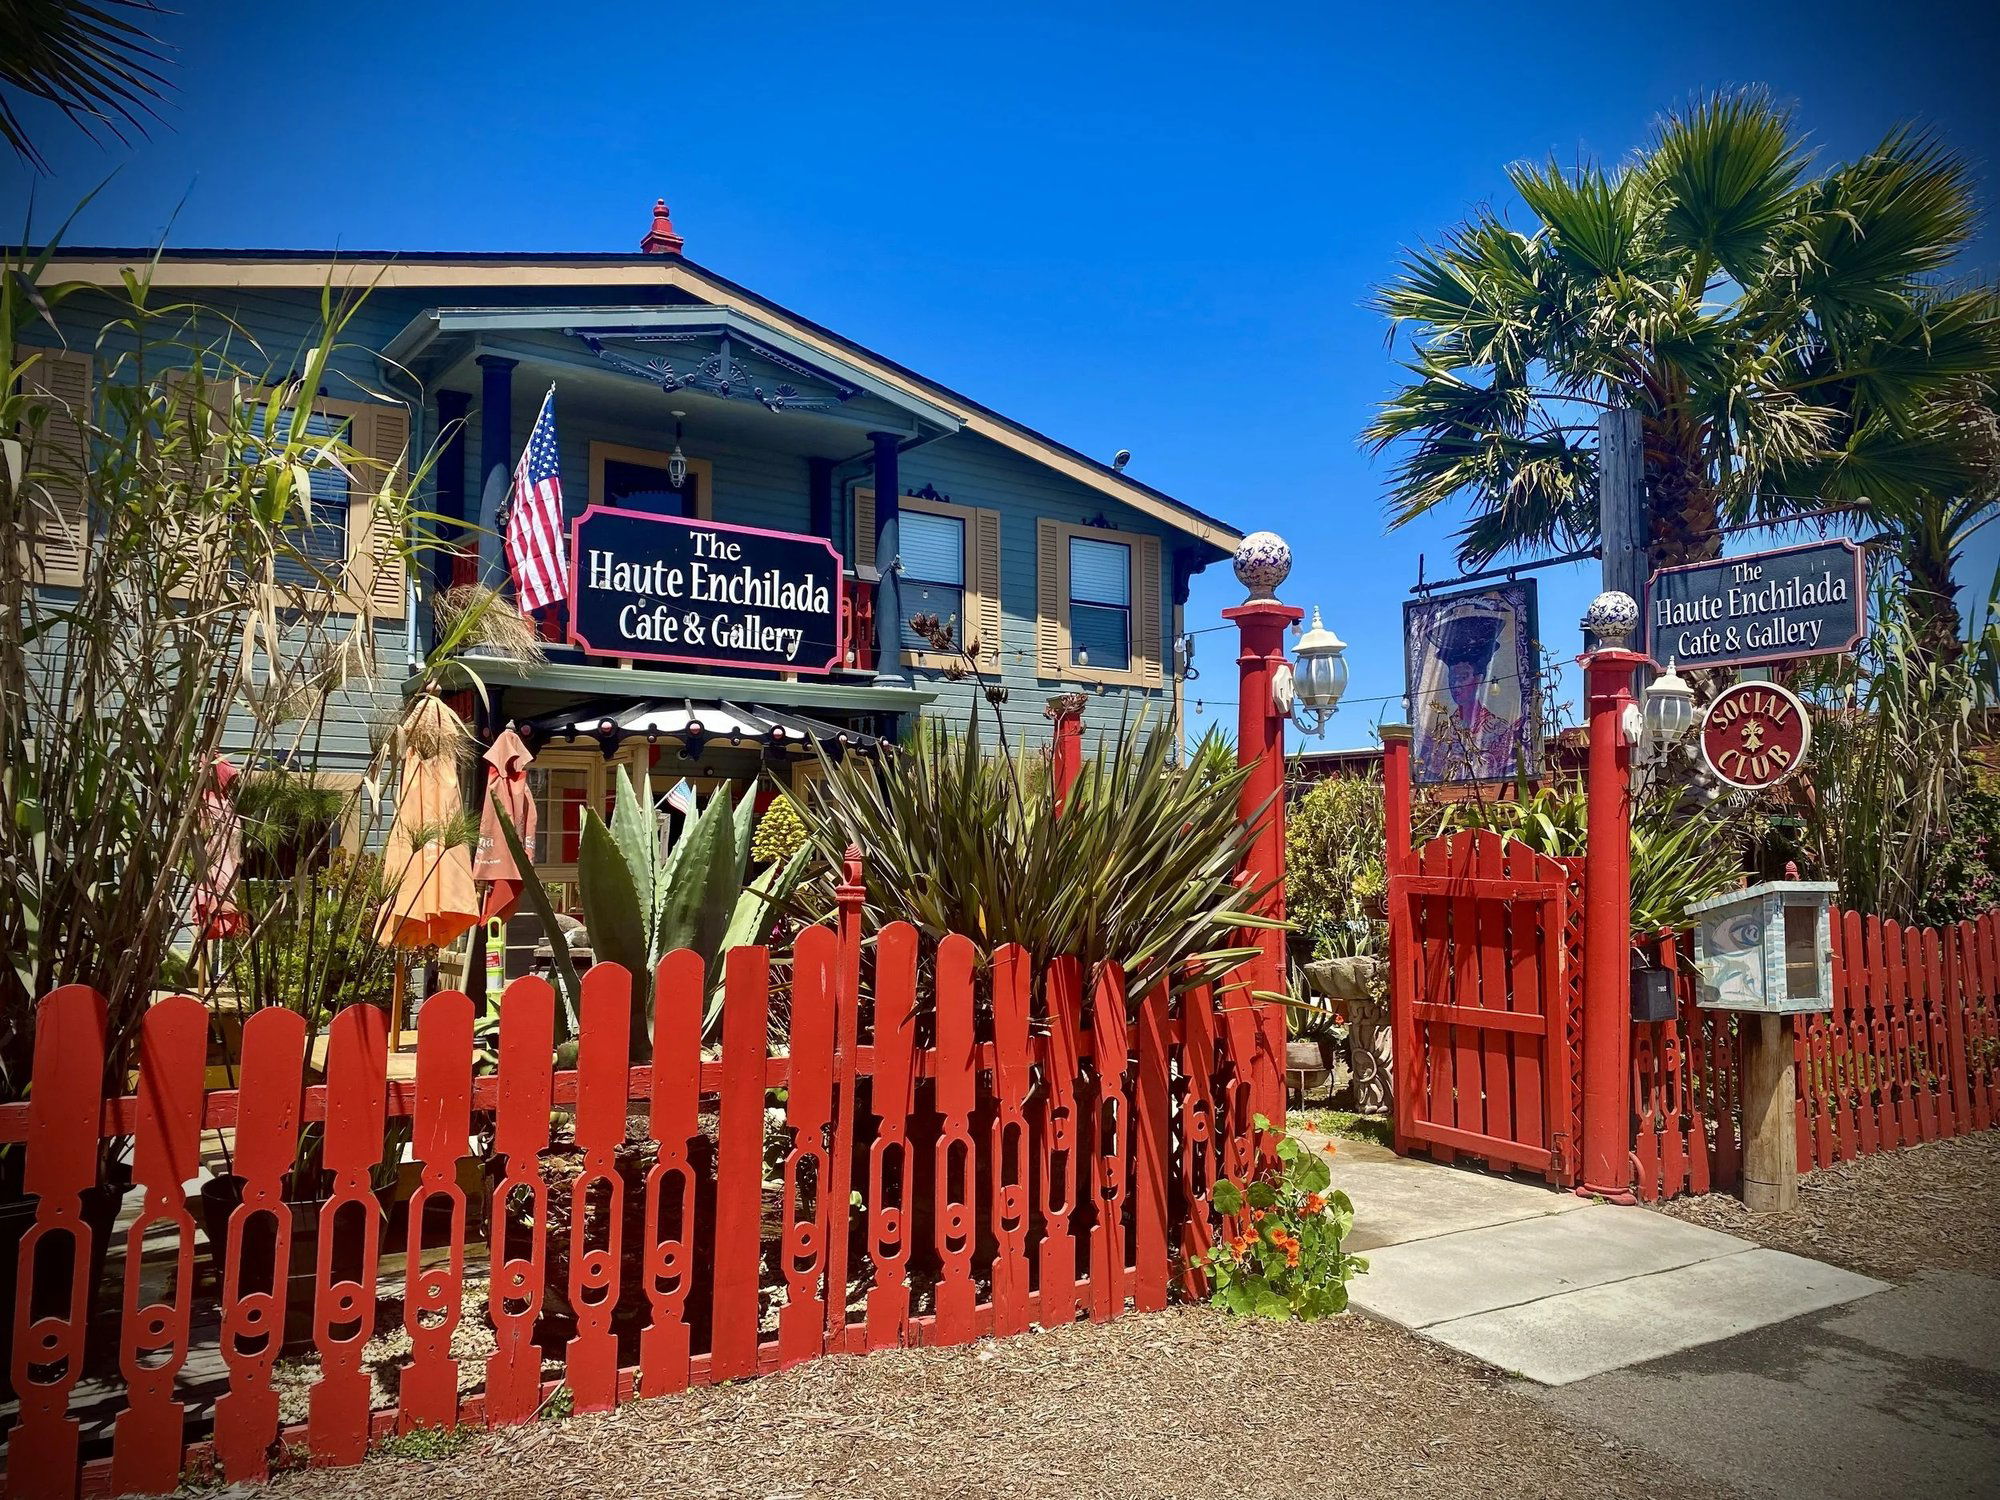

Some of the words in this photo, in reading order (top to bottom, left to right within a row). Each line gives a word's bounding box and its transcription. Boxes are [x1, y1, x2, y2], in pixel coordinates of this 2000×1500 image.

[689, 531, 742, 561] The
[588, 549, 683, 598] Haute
[690, 562, 830, 614] Enchilada
[1732, 562, 1763, 584] The
[1656, 594, 1723, 627] Haute
[1727, 571, 1848, 617] Enchilada
[619, 604, 678, 643] Cafe
[683, 611, 706, 646] &
[711, 613, 804, 662] Gallery
[1678, 626, 1721, 657] Cafe
[1725, 625, 1742, 651] &
[1746, 617, 1823, 648] Gallery
[1711, 691, 1792, 730] SOCIAL
[1718, 744, 1791, 779] CLUB
